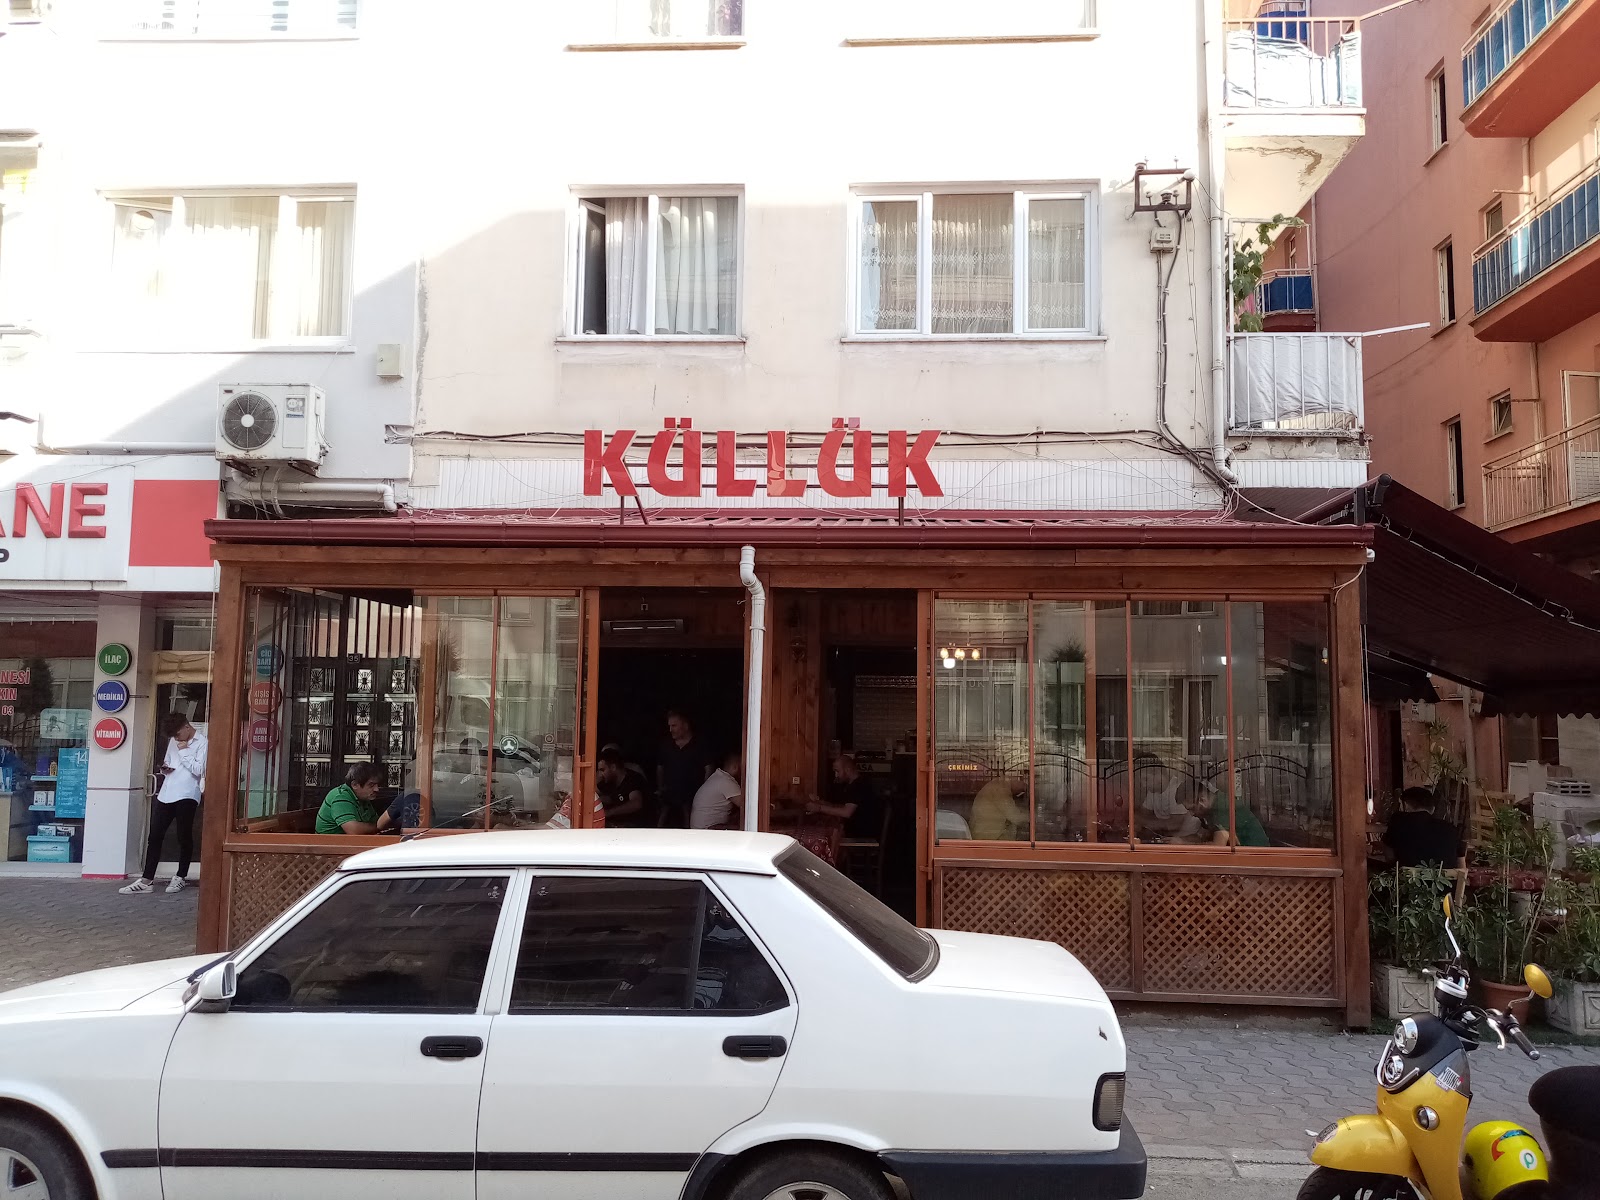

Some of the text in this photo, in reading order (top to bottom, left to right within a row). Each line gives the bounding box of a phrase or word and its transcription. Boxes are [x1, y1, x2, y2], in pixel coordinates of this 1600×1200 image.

[583, 417, 944, 498] KÜLLÜK
[0, 482, 109, 539] NE
[104, 653, 122, 665] İLAÇ
[97, 692, 124, 701] MEDİKAL
[96, 728, 121, 738] VİTAMİN
